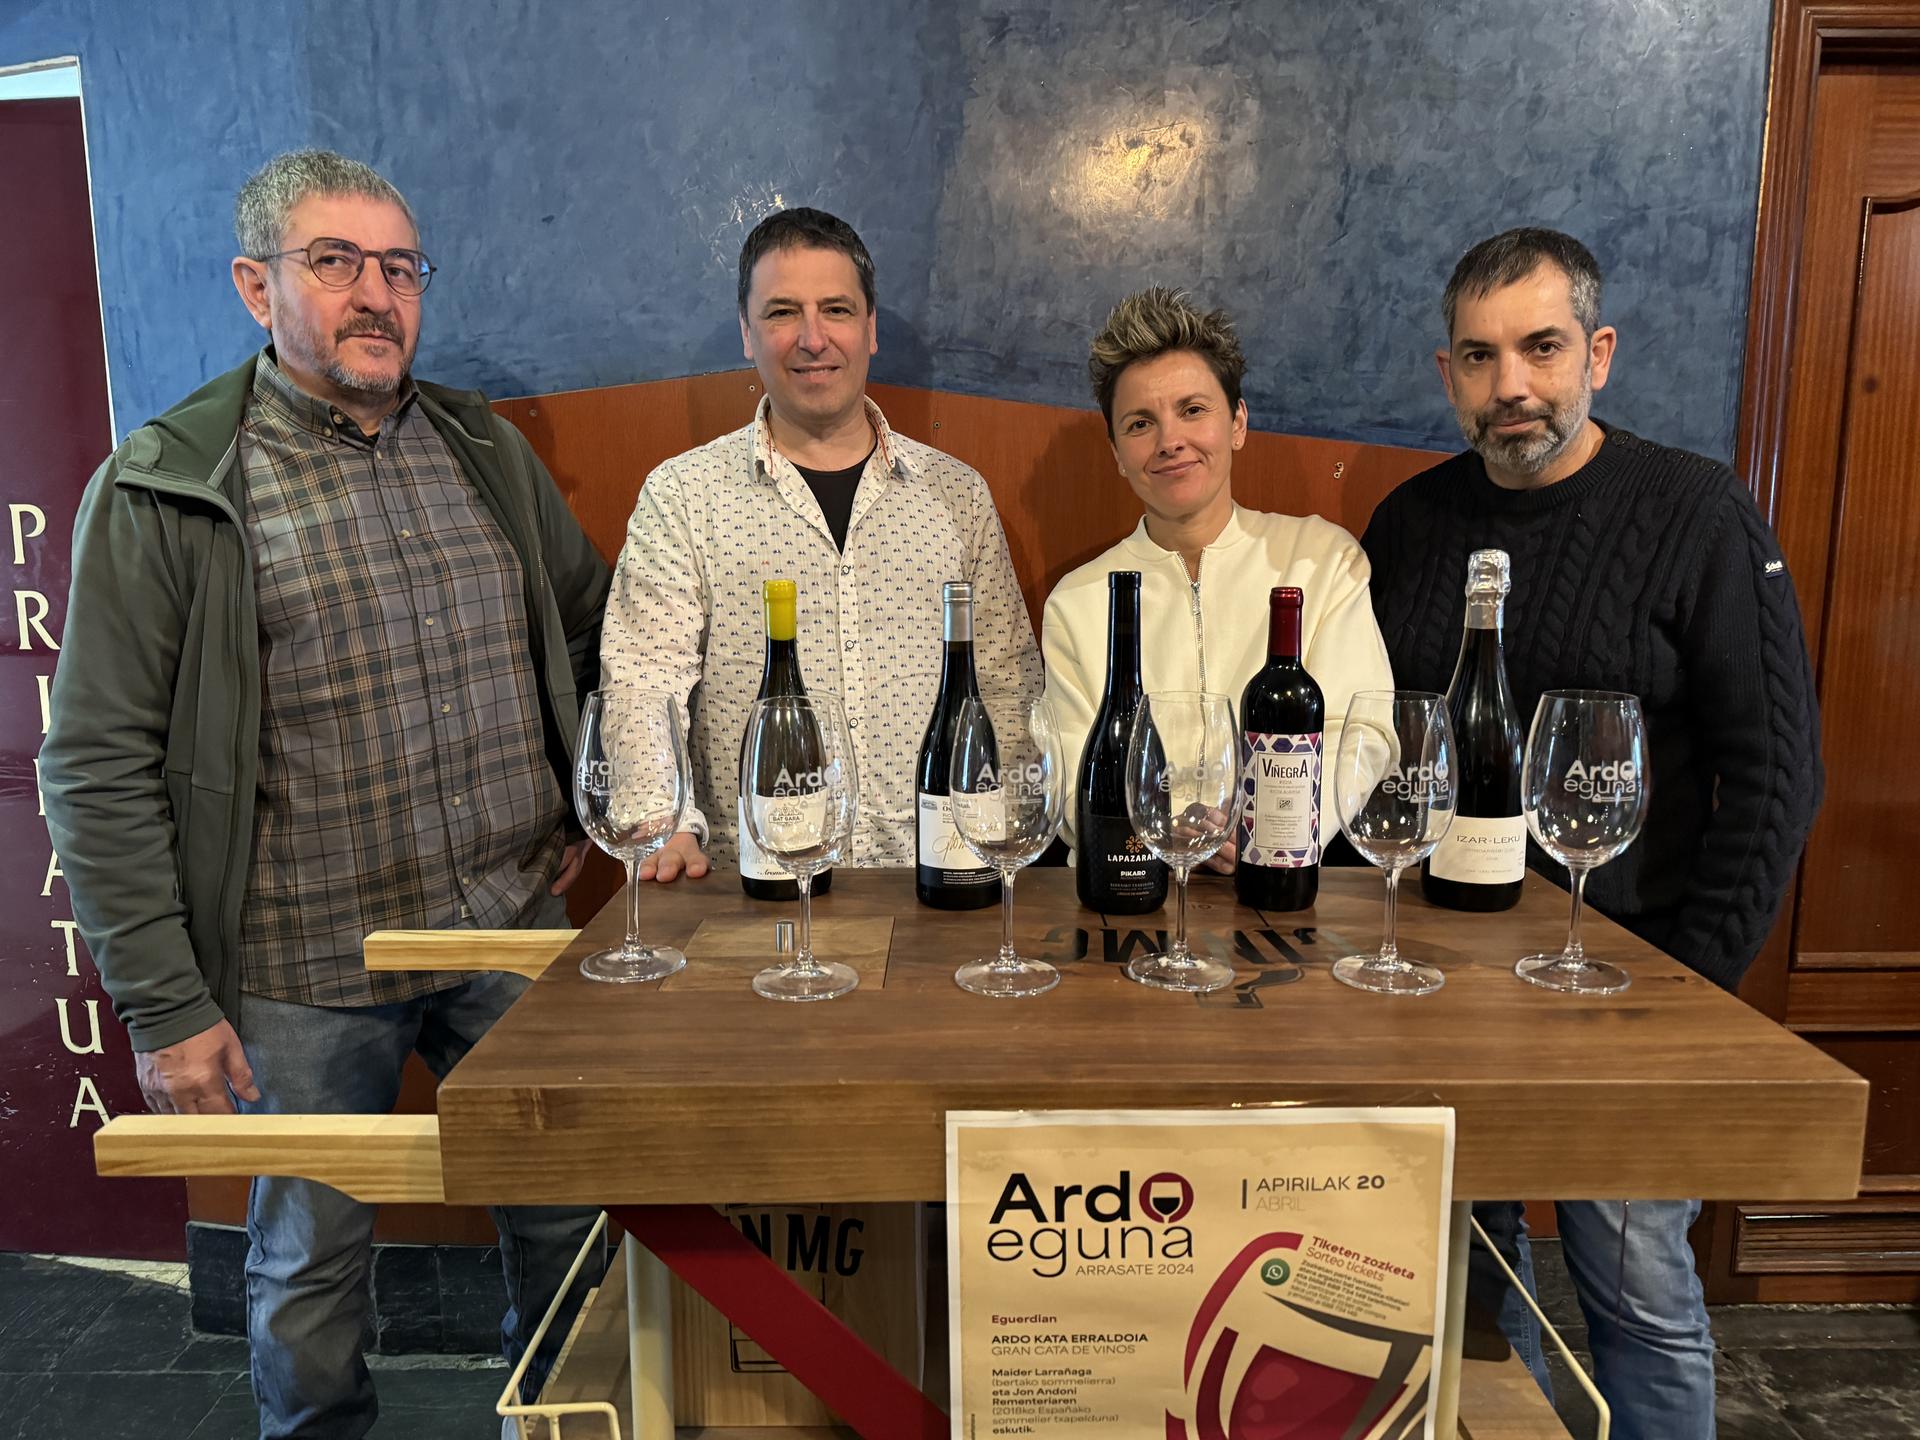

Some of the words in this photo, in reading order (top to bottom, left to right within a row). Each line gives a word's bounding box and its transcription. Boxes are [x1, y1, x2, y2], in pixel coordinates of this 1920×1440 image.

[1262, 758, 1309, 779] VIÑEGRA
[1382, 779, 1449, 801] eguna
[1563, 779, 1637, 800] eguna
[10, 503, 111, 1129] PRIATUA
[1456, 835, 1520, 844] IZAR-LEKU
[1256, 1176, 1350, 1192] APIRILAK
[1356, 1175, 1385, 1189] 20
[1255, 1195, 1306, 1212] ABRIL
[987, 1226, 1193, 1278] eguna
[1312, 1235, 1361, 1261] Tiketen
[1362, 1255, 1415, 1280] zozketa
[1075, 1264, 1154, 1276] ARRASATE
[1157, 1263, 1194, 1275] 2024
[1306, 1246, 1345, 1268] Sorteo
[1346, 1261, 1385, 1282] tickets
[991, 1314, 1057, 1325] Eguerdian
[991, 1335, 1031, 1344] ARDO
[1034, 1334, 1068, 1343] KATA
[1071, 1333, 1148, 1343] ERRALDOIA
[991, 1346, 1031, 1356] GRAN
[1034, 1346, 1069, 1355] CATA
[1072, 1345, 1090, 1354] DE
[1093, 1344, 1136, 1354] VINOS
[992, 1368, 1033, 1377] Maider
[1035, 1367, 1092, 1377] Larrañaga
[991, 1378, 1039, 1387] (bertako
[1041, 1376, 1116, 1386] sommelierra)
[1012, 1388, 1034, 1396] Jon
[1036, 1387, 1077, 1396] Andoni
[992, 1397, 1077, 1406] Rementeriaren
[1038, 1406, 1092, 1415] Españako
[992, 1416, 1051, 1425] sommelier
[1053, 1414, 1119, 1424] txapelduna)
[992, 1425, 1036, 1435] eskutik.
